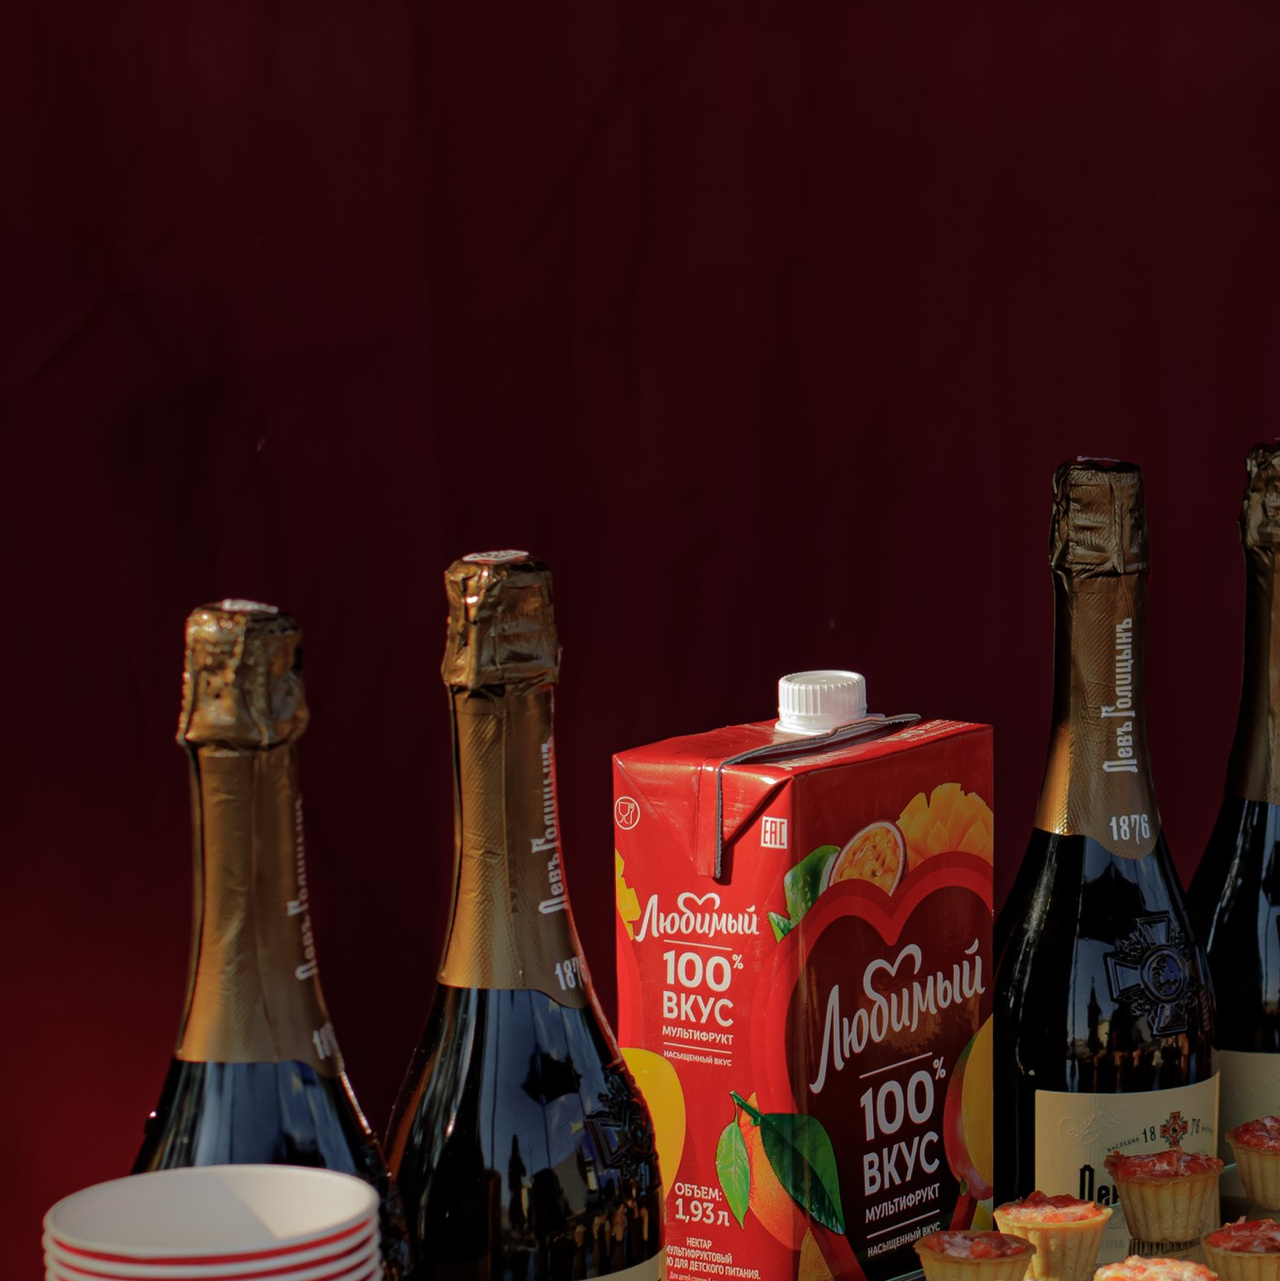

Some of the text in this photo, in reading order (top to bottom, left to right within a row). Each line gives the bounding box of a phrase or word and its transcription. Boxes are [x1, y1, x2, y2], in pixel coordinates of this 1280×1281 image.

[1101, 617, 1138, 773] Левъ Голицынъ
[1110, 814, 1150, 845] 1876
[635, 892, 760, 942] Любимый
[663, 950, 744, 992] 100%
[663, 990, 734, 1027] ВКУС
[809, 938, 986, 1094] Любимый
[662, 1025, 734, 1046] МУЛЬТИФРУКТ
[663, 1050, 733, 1067] НАСЫЩЕННЫЙ ВКУС
[860, 1056, 946, 1141] 100%
[1142, 1126, 1156, 1143] 18
[863, 1131, 940, 1196] ВКУС
[675, 1182, 722, 1201] ОБЪЕМ:
[866, 1182, 940, 1224] МУЛЬТИФРУКТ
[675, 1198, 730, 1227] 1,93 л
[686, 1236, 712, 1249] НЕКТАР
[867, 1221, 941, 1258] НАСЫЩЕННЫЙ ВКУС
[674, 1257, 688, 1269] ДЛЯ
[689, 1260, 724, 1275] ДЕТСКОГО
[725, 1266, 761, 1280] ПИТАНИЯ.
